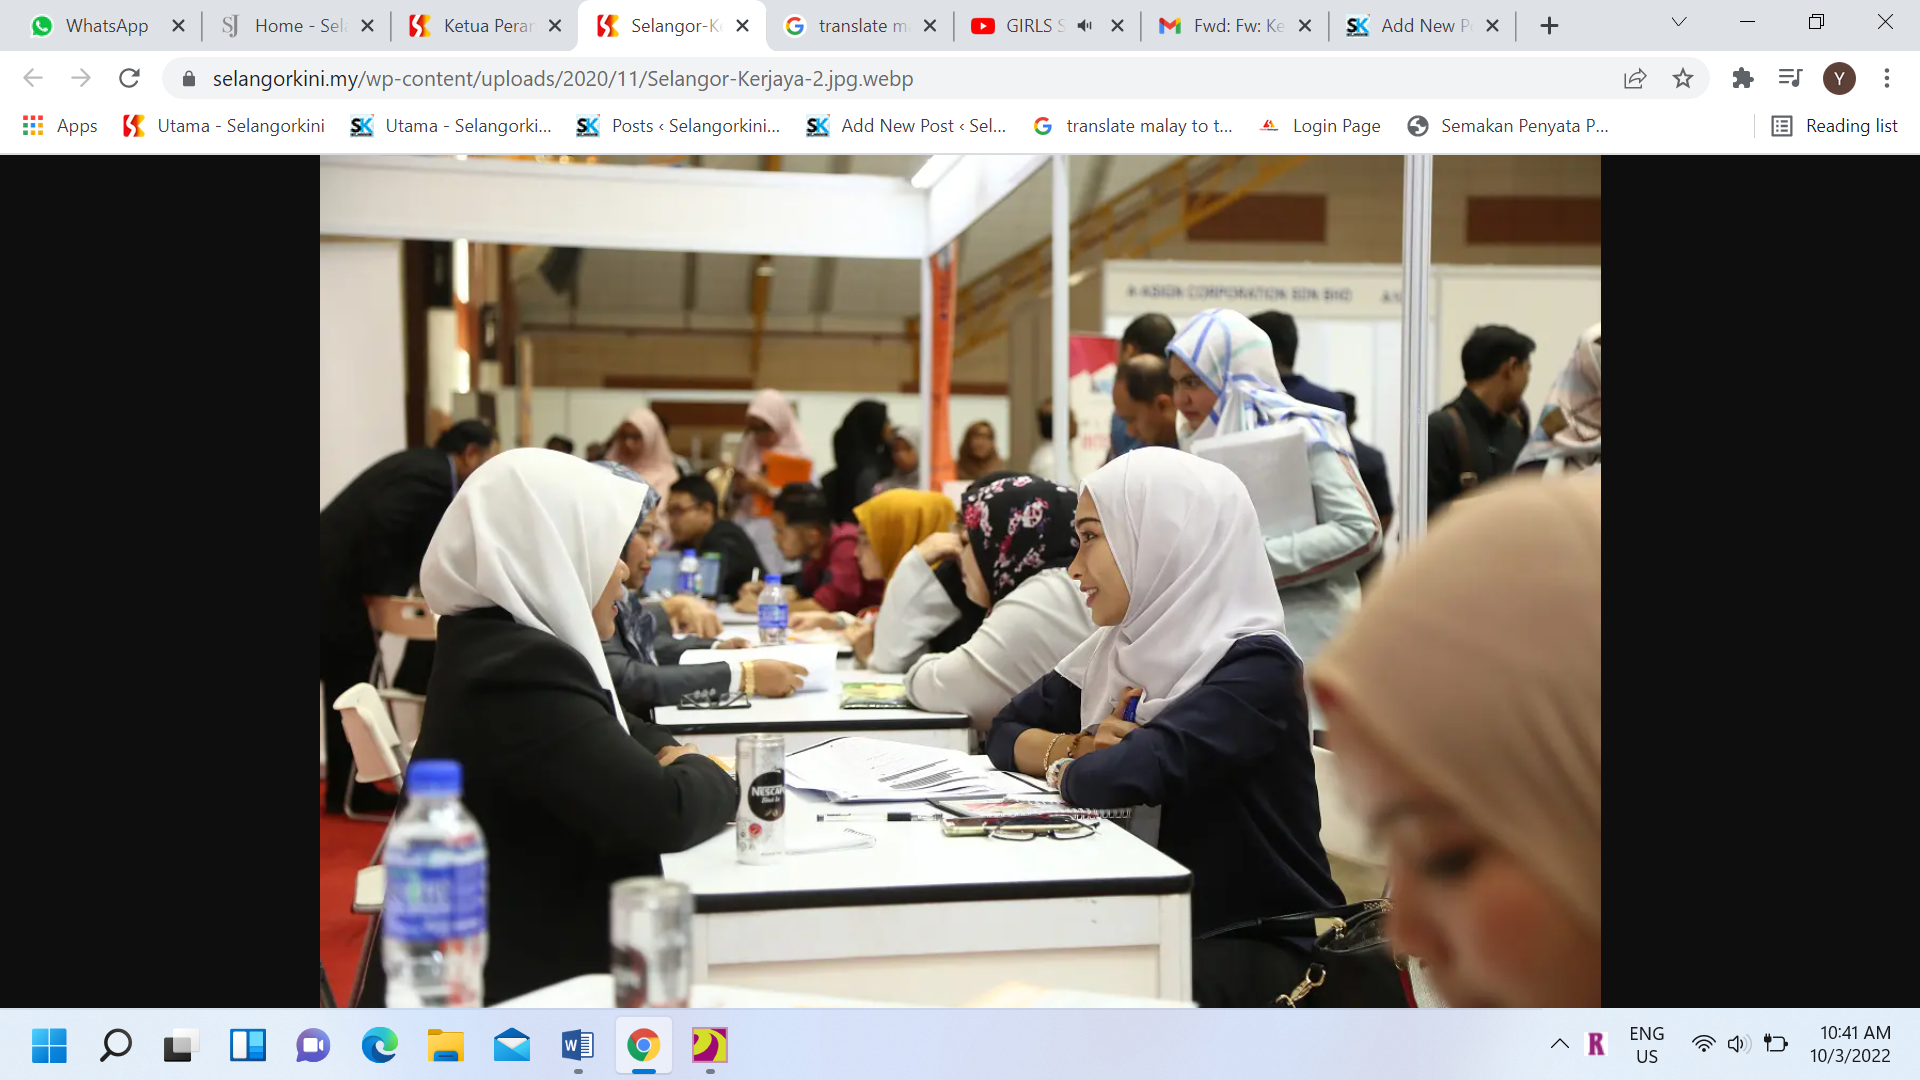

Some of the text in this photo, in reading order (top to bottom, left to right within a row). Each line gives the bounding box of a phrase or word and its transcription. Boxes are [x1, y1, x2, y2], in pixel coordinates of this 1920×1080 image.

[66, 18, 148, 36] WhatsApp
[256, 19, 303, 32] Home
[445, 19, 489, 32] Ketua
[819, 18, 887, 32] translate
[1007, 19, 1052, 32] GIRLS
[1195, 18, 1230, 32] Fwd:
[1236, 19, 1261, 32] Fw:
[1382, 18, 1414, 32] Add
[1420, 19, 1455, 32] New
[213, 70, 914, 91] selangorkini.my/wp-content/uploads/2020/11/Selangor-Kerjaya-2.jpg.webp
[1834, 71, 1846, 86] Y
[57, 119, 97, 136] Apps
[158, 119, 210, 132] Utama
[227, 118, 325, 136] Selangorkini
[386, 119, 438, 132] Utama
[613, 119, 653, 132] Posts
[842, 118, 874, 132] Add
[880, 119, 915, 132] New
[921, 119, 954, 132] Post
[1067, 118, 1135, 132] translate
[1141, 118, 1187, 136] malay
[1191, 120, 1208, 132] to
[1294, 119, 1381, 136] Login Page
[1442, 118, 1513, 132] Semakan
[1519, 119, 1580, 136] Penyata
[1807, 118, 1898, 136] Reading list
[751, 784, 785, 797] NESCAF
[1631, 1027, 1664, 1040] ENG
[1821, 1026, 1890, 1039] 10:41 AM
[1588, 1032, 1605, 1056] R
[1637, 1050, 1658, 1063] US
[1810, 1049, 1890, 1064] 10/3/2022
